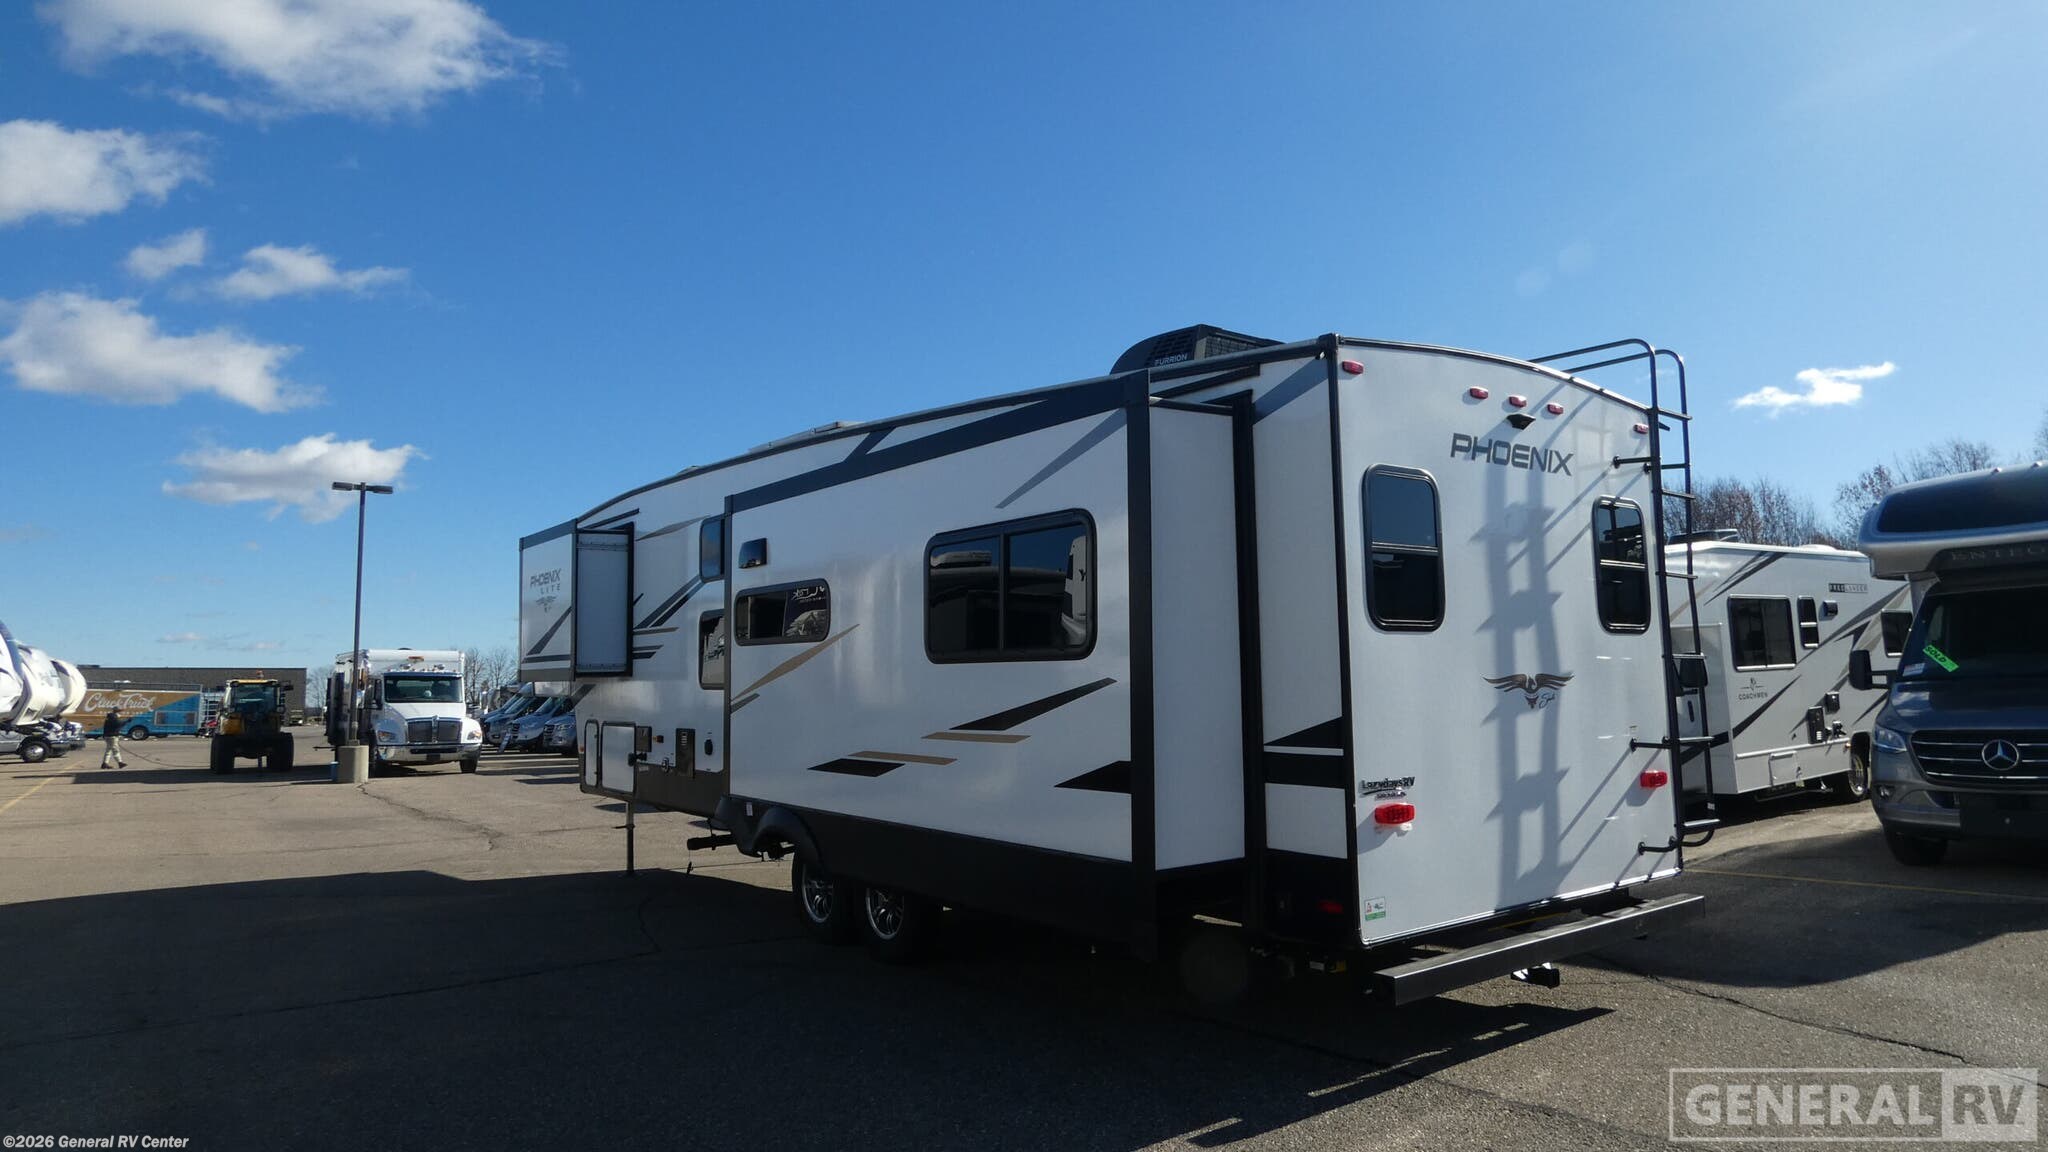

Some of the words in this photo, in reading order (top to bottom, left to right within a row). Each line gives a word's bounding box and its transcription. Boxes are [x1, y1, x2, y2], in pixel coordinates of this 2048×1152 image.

[1154, 352, 1188, 366] FURRION
[1450, 433, 1574, 476] PHOENIX
[530, 568, 561, 587] PHOENIX
[541, 585, 561, 594] LITE
[1926, 645, 1947, 664] SOLD
